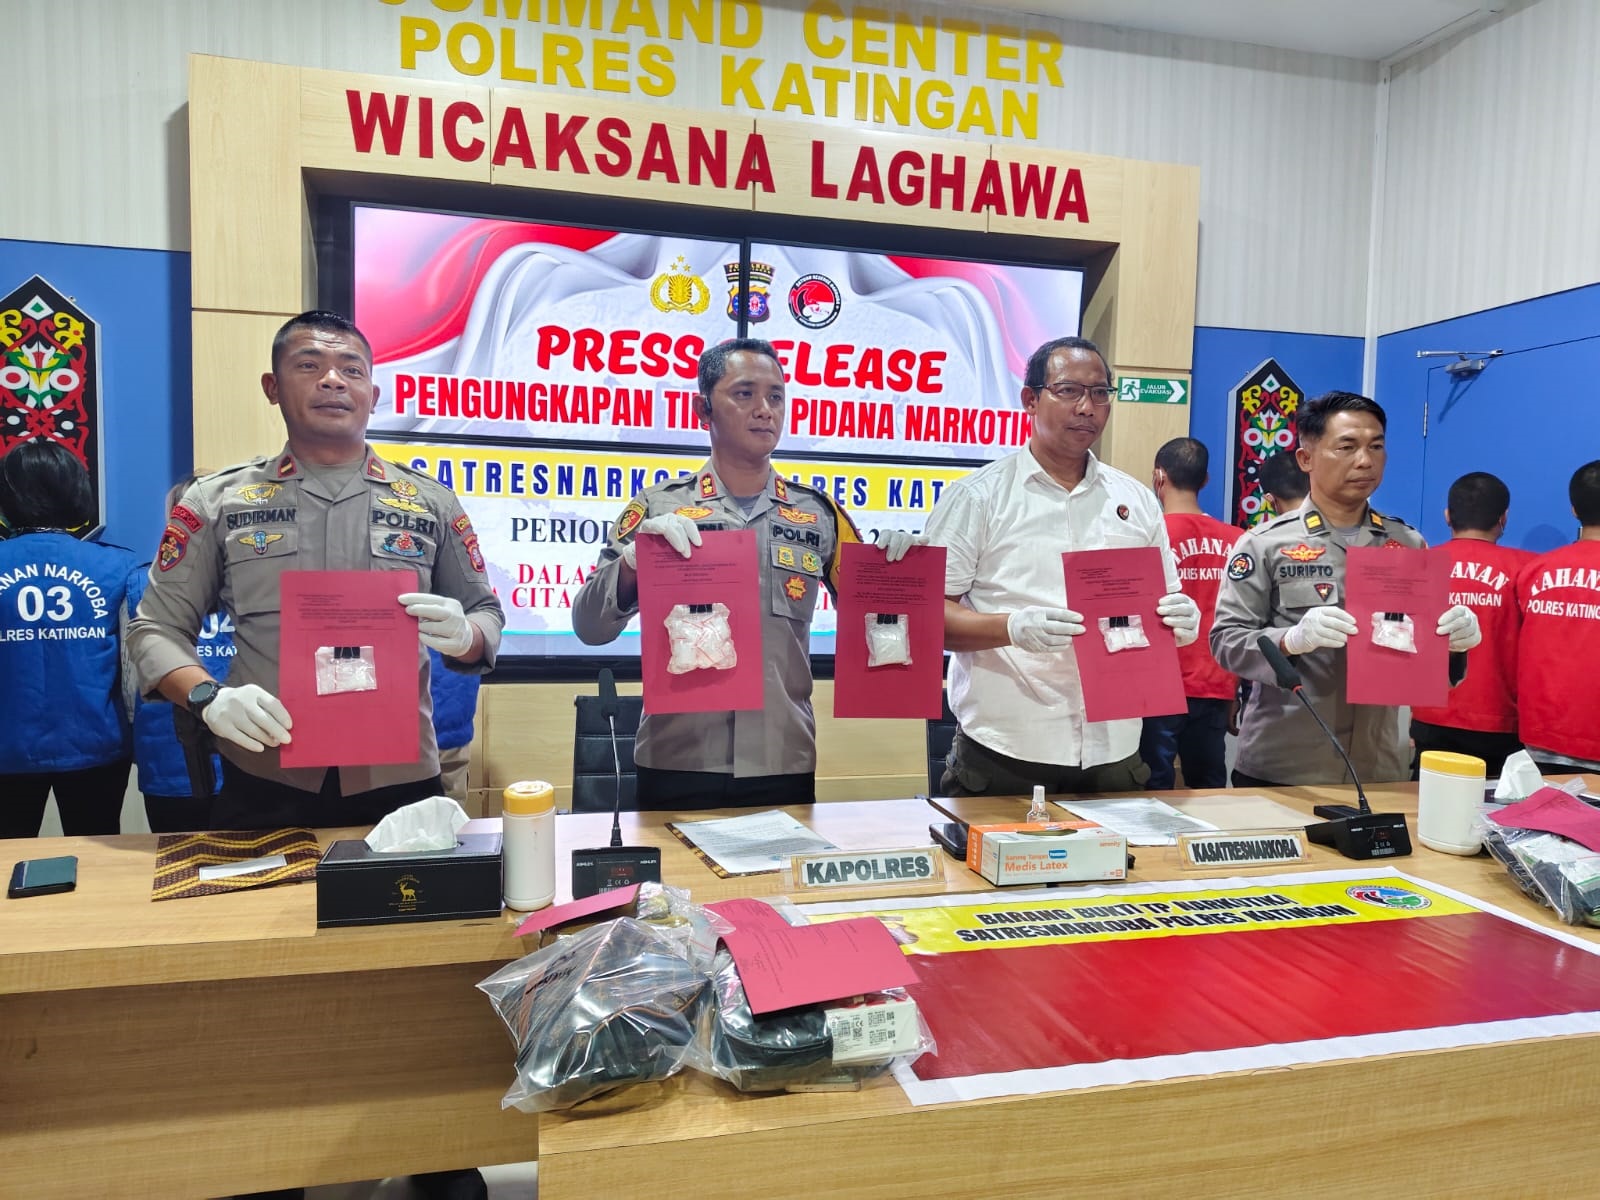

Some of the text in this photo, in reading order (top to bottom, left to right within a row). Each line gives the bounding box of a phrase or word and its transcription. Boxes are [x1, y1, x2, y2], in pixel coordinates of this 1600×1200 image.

[803, 0, 1064, 87] CENTER
[400, 16, 1038, 139] POLRES KATINGAN
[346, 90, 1090, 223] WICAKSANA LAGHAWA
[537, 325, 947, 393] PRESS ELEASE
[395, 374, 653, 427] PENGUNGKAPAN
[790, 398, 894, 439] PIDANA
[905, 405, 1033, 446] NARKOTIK
[226, 508, 297, 530] SUDIRMAN
[371, 510, 436, 535] POLRI
[772, 525, 821, 547] POLRI
[517, 563, 597, 585] DALA
[1279, 564, 1333, 578] SURIPTO
[1450, 561, 1510, 591] ANAN
[0, 563, 109, 619] ANAN NARKOBA
[17, 585, 74, 622] 03
[512, 587, 571, 608] CITA
[1448, 592, 1502, 607] KATINGAN
[1566, 602, 1600, 619] KATING
[0, 627, 106, 642] LRES KATINGAN
[1192, 838, 1300, 862] KASATRESNARKOBA
[806, 856, 930, 884] KAPOLRES
[1005, 861, 1069, 872] Medis Latex
[976, 894, 1299, 925] BARANG BUKTI TP NARKOTIKA
[956, 904, 1358, 942] SATRESNARKOBA POLRES KATINGAN
